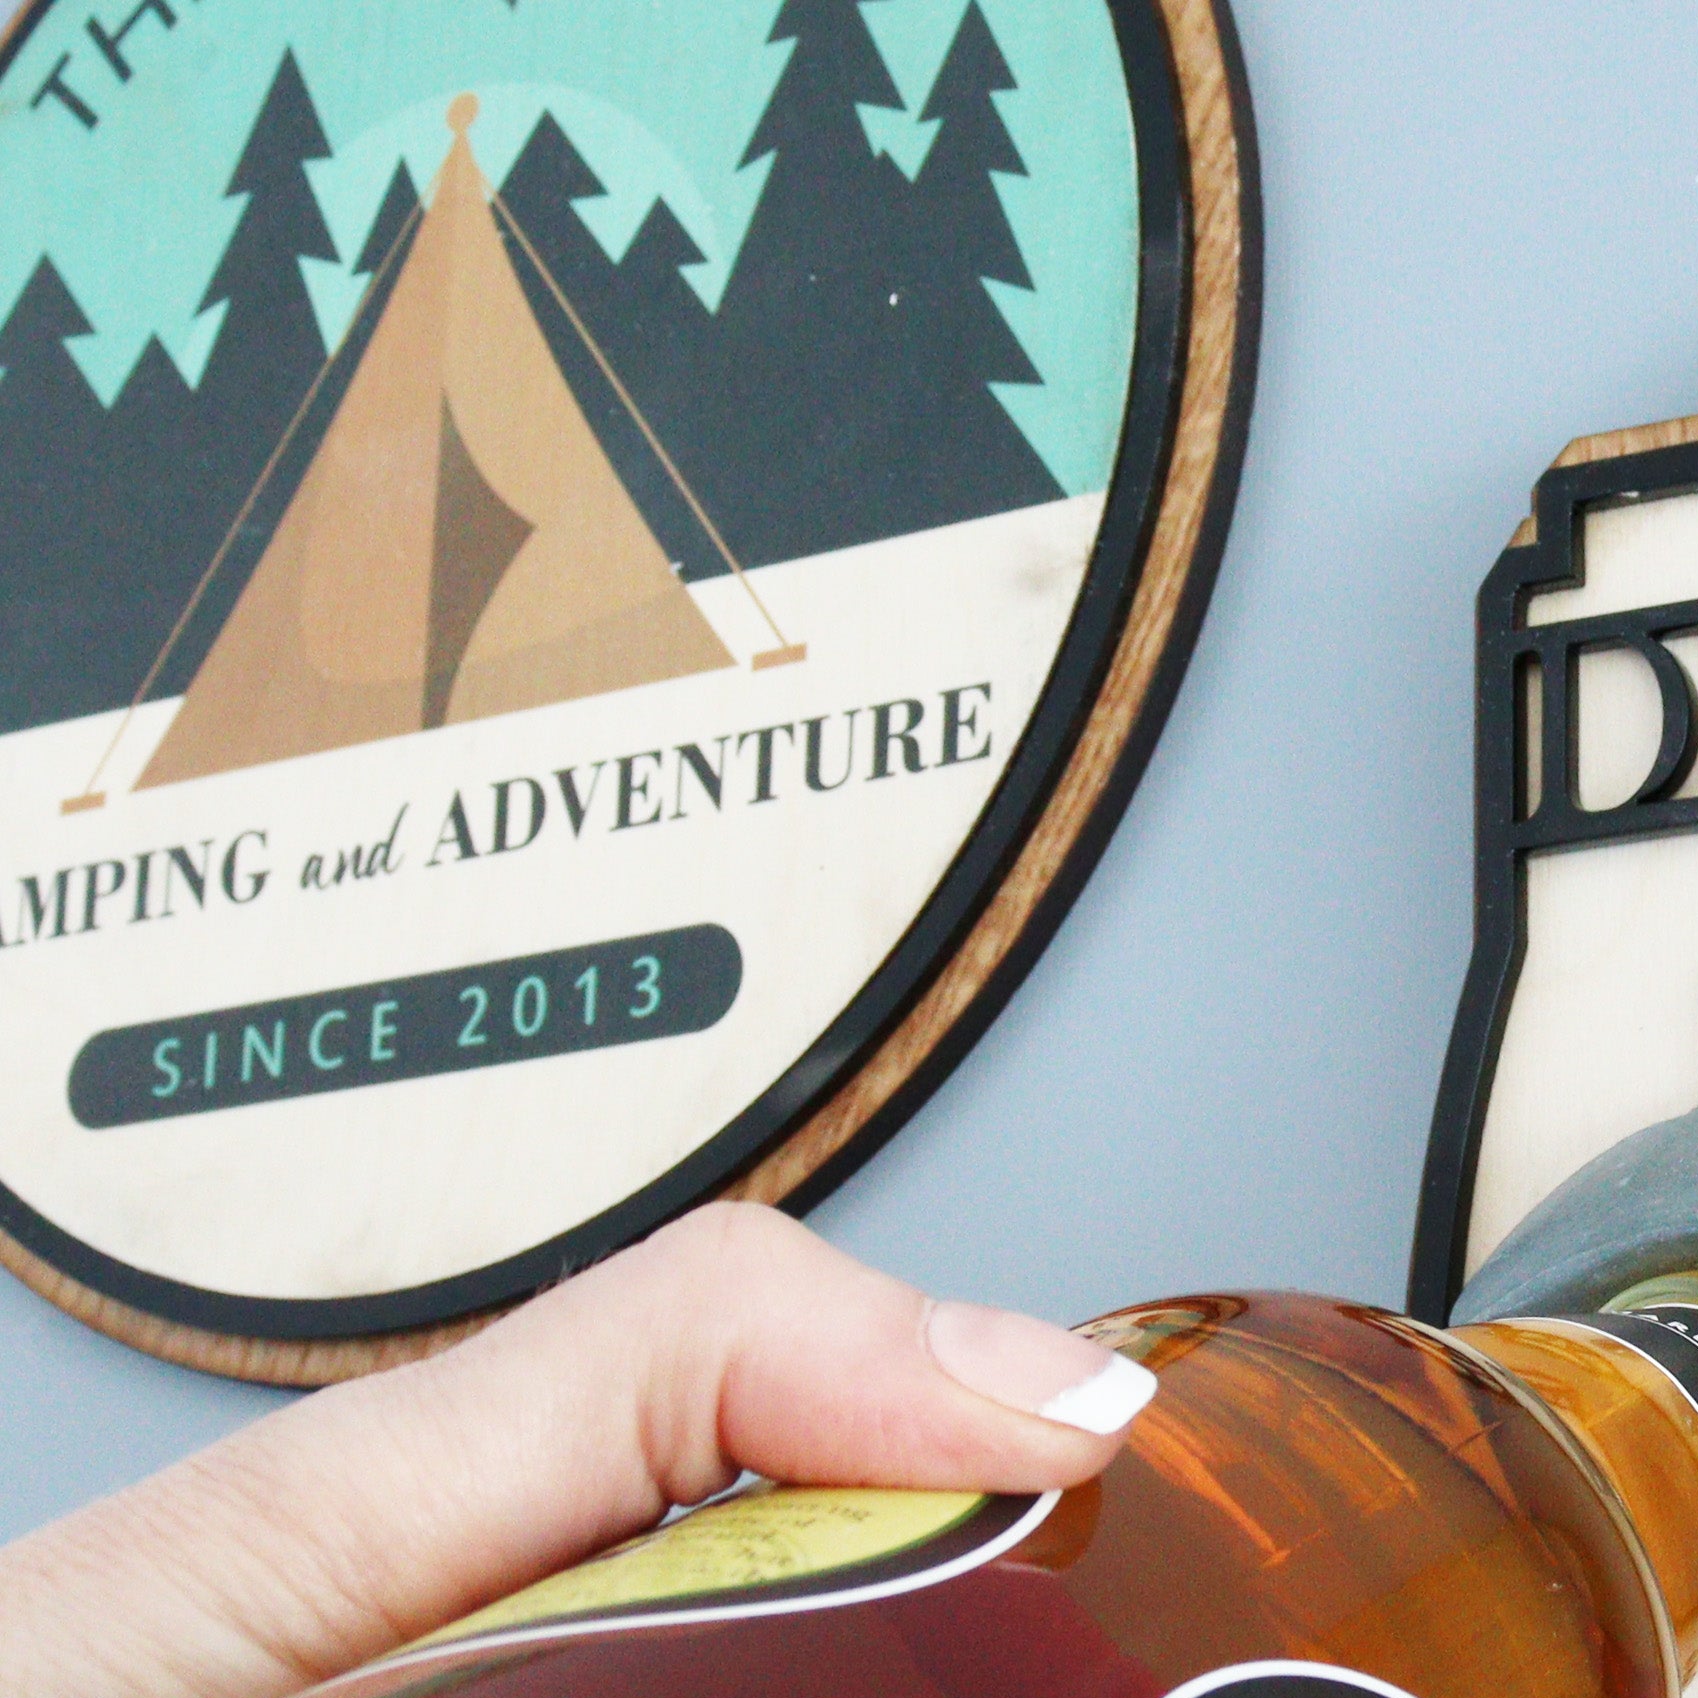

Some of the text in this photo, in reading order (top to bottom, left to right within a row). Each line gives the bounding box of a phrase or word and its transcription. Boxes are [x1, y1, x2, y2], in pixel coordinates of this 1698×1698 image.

[298, 802, 411, 891] and
[424, 682, 992, 868] ADVENTURE
[152, 955, 662, 1098] SINCE 2013
